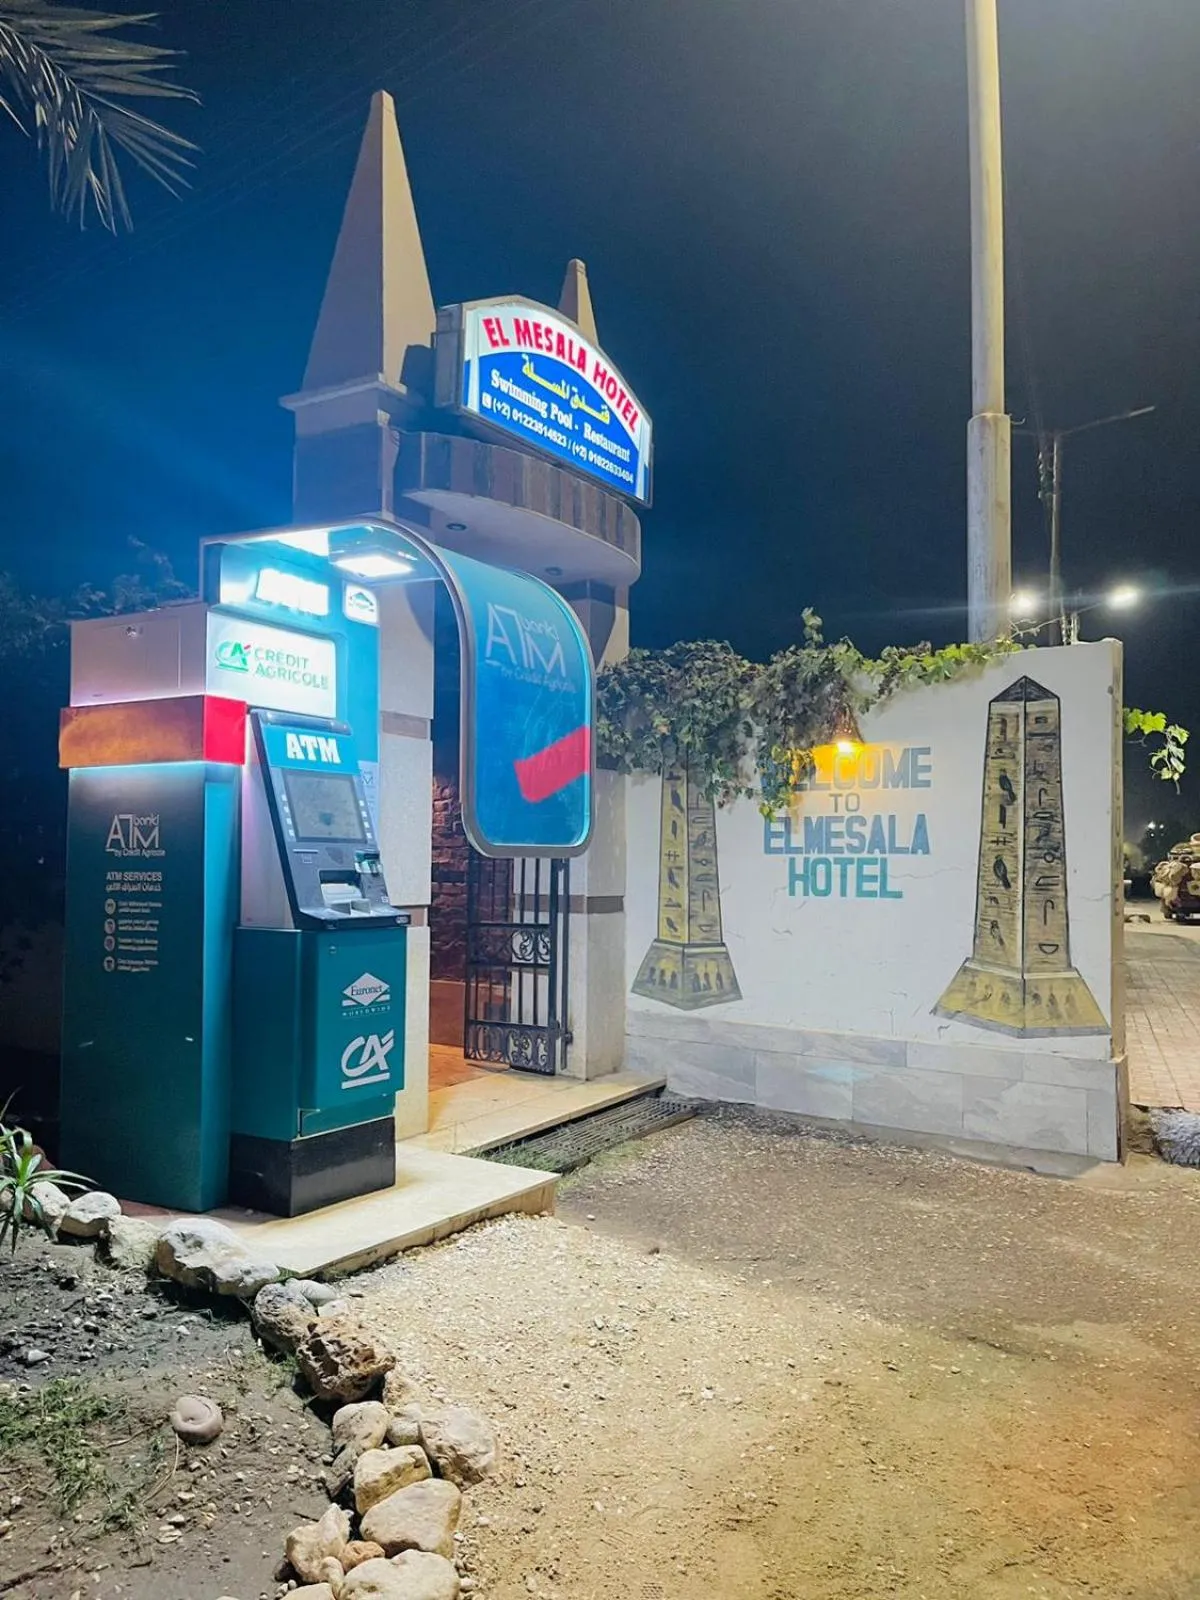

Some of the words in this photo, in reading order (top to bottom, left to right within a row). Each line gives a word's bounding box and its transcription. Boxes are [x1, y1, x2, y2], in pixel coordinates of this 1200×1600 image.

[482, 317, 510, 348] EL
[513, 318, 587, 373] MESALA
[592, 361, 642, 433] HOTEL
[490, 369, 549, 419] Swimming
[550, 402, 574, 430] Pool
[583, 422, 631, 463] Restaurant
[254, 663, 329, 690] AGRICOLE
[286, 733, 341, 764] ATM
[829, 793, 860, 813] TO
[106, 814, 159, 849] ATM
[106, 871, 122, 880] ATM
[123, 871, 162, 882] SERVICES
[788, 856, 903, 899] HOTEL
[351, 985, 383, 996] Euronet
